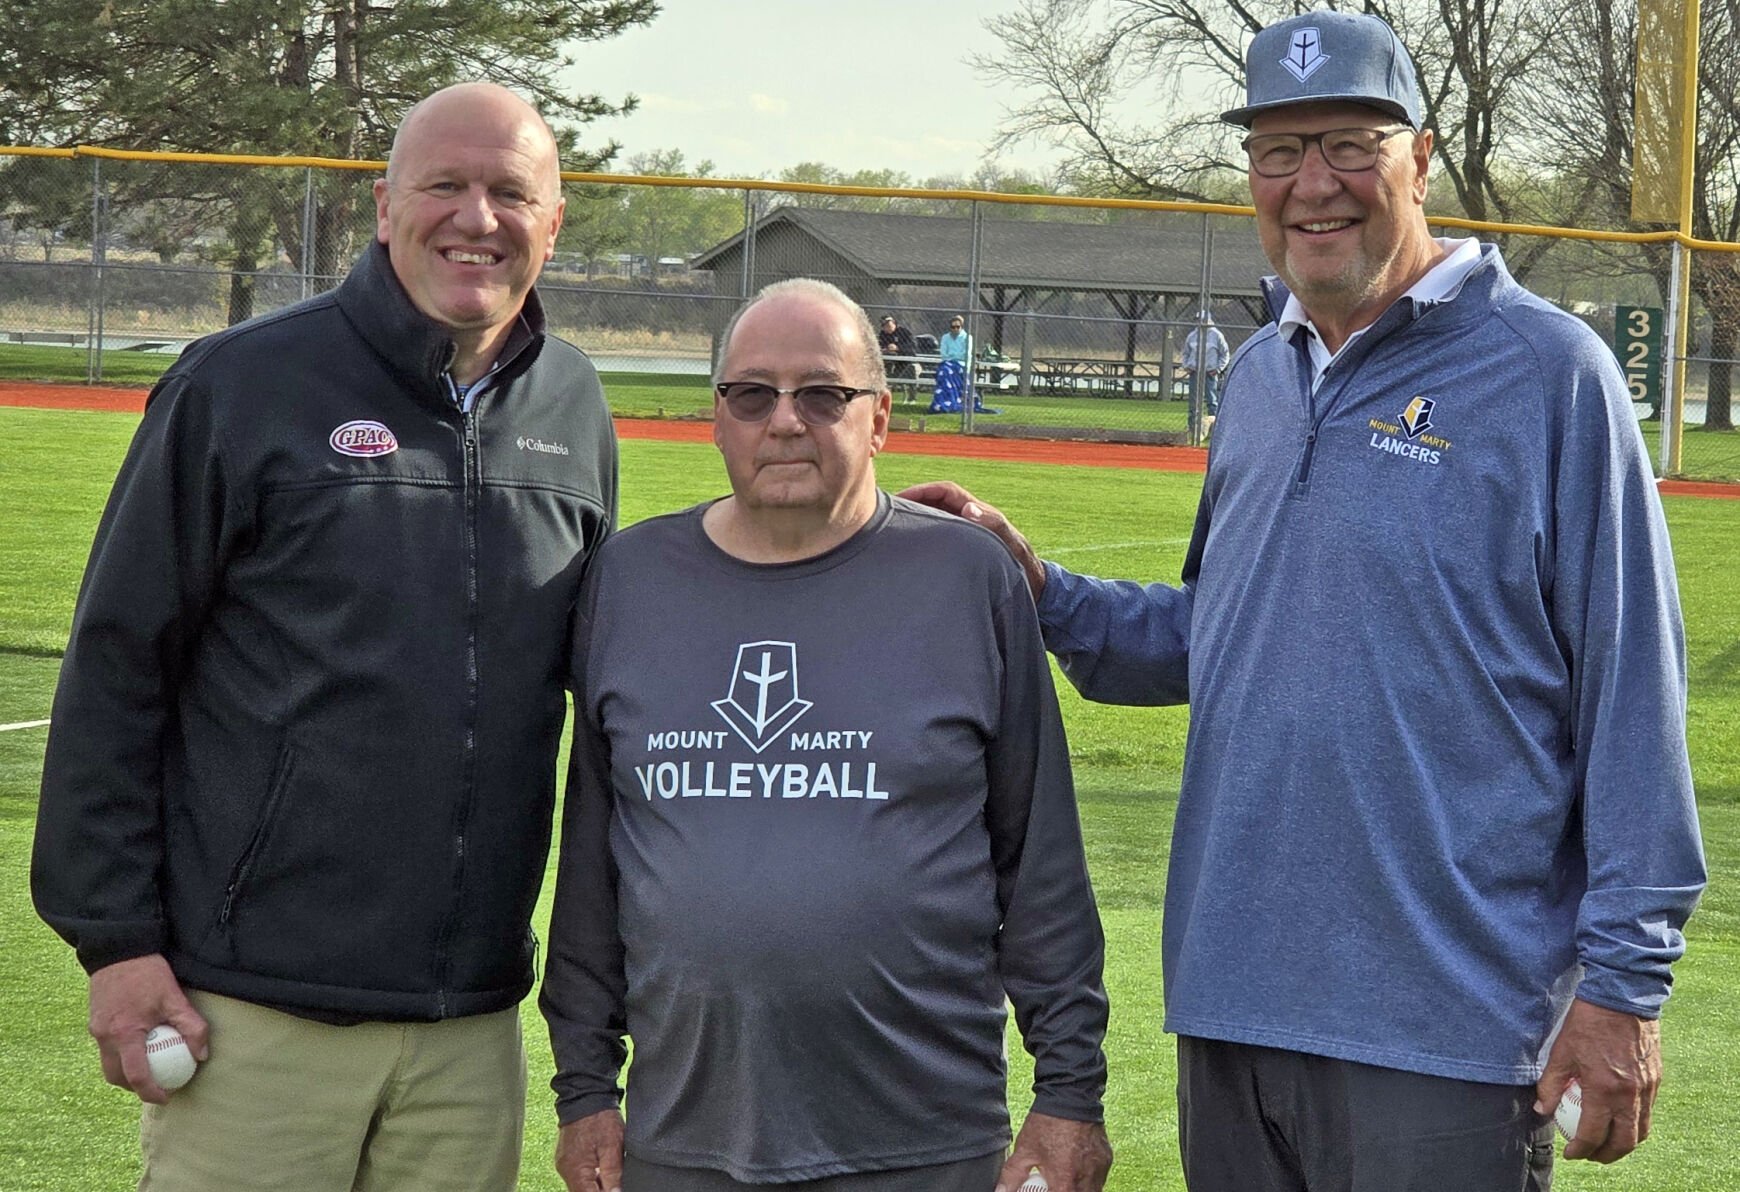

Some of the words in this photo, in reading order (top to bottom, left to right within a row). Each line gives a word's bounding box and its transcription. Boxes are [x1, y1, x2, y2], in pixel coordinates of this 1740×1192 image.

[339, 428, 389, 445] GPAC
[526, 438, 569, 456] Columbia
[1368, 419, 1401, 435] MOUNT
[1420, 433, 1453, 451] MARTY
[1369, 432, 1441, 465] LANCERS
[647, 731, 728, 751] MOUNT
[790, 731, 873, 750] MARTY
[634, 761, 889, 801] VOLLEYBALL
